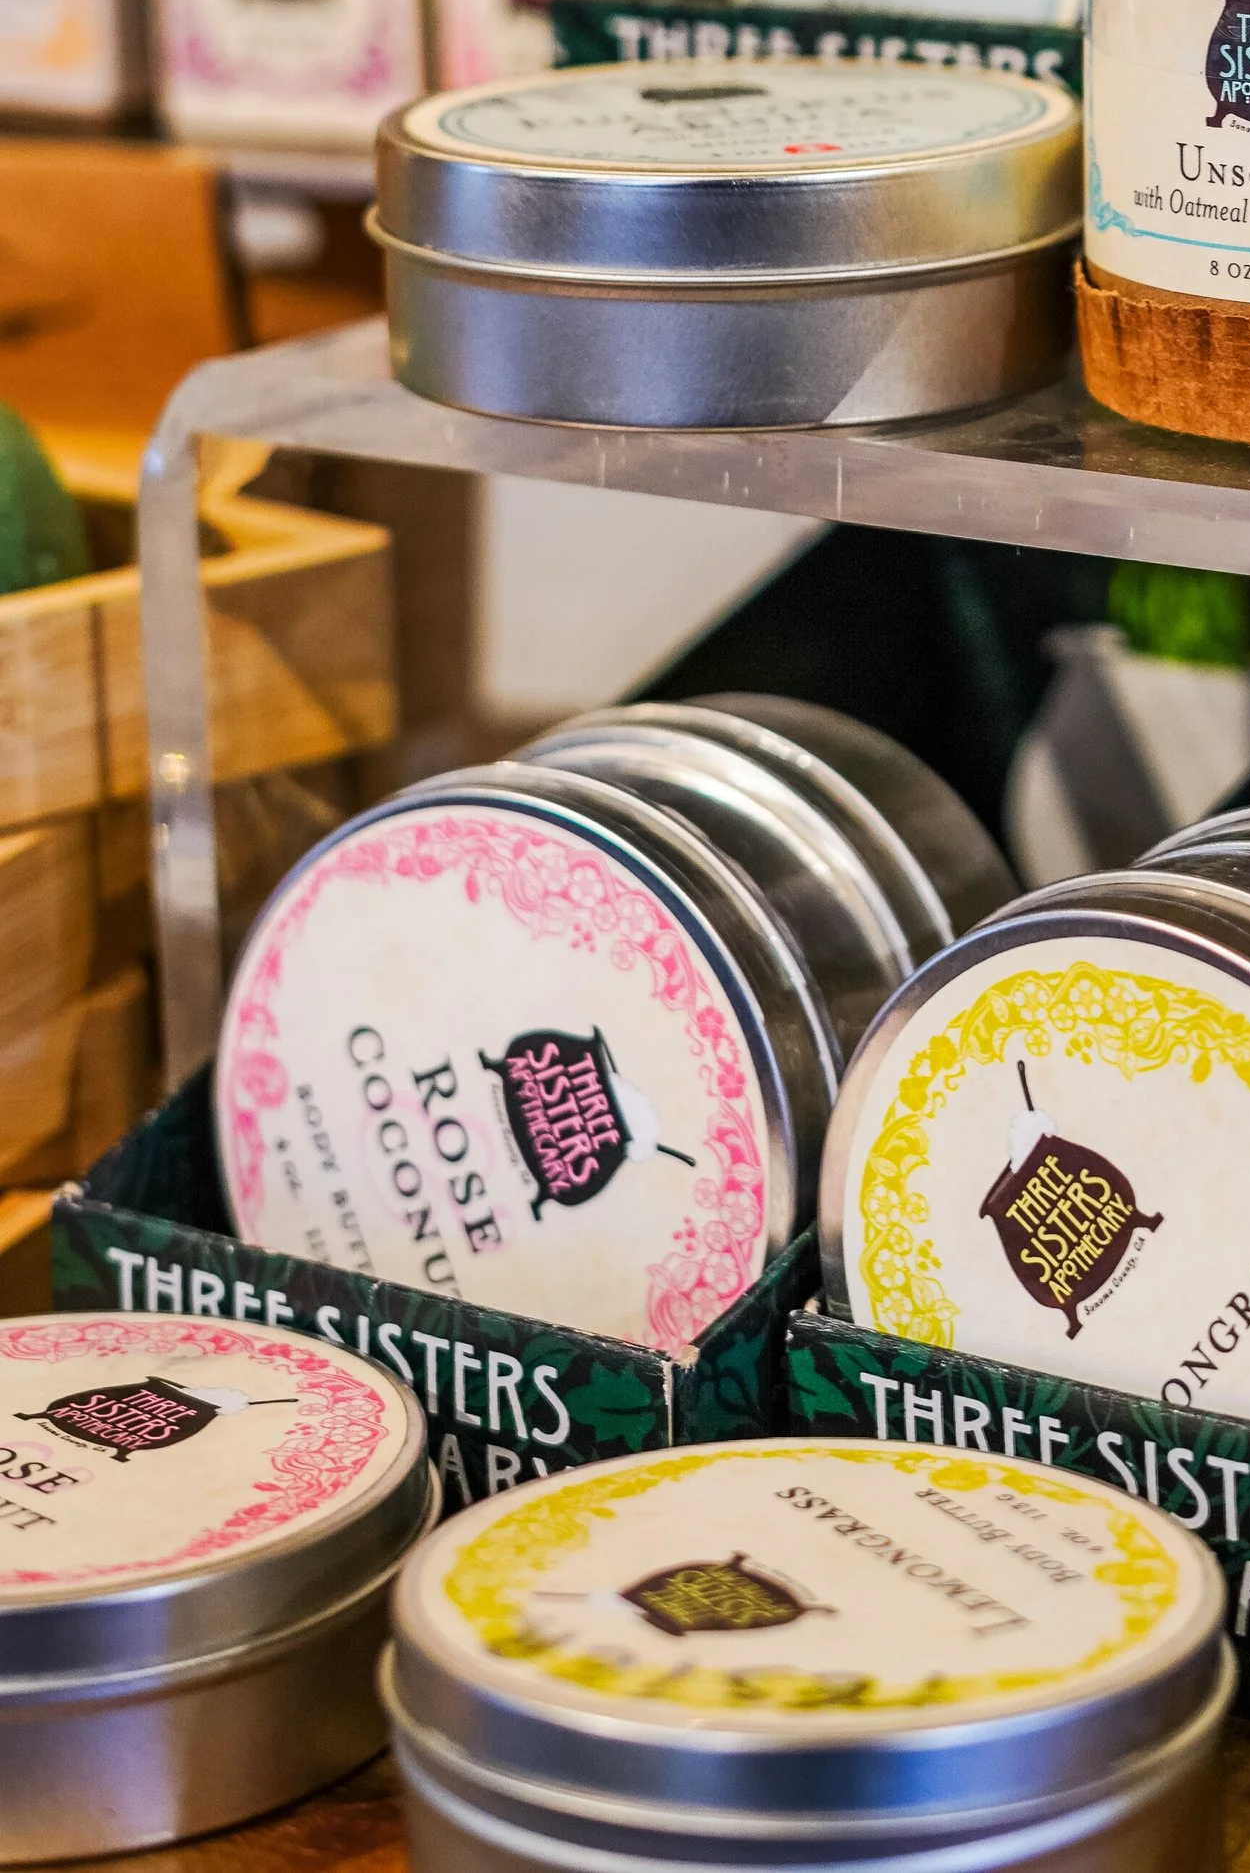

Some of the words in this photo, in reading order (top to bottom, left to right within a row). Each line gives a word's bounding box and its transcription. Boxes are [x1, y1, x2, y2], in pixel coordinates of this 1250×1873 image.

[1134, 186, 1164, 212] with
[1169, 189, 1248, 225] Oatmeal
[1210, 260, 1219, 277] 8
[525, 1042, 600, 1185] SISTERS
[567, 1051, 621, 1150] THREE
[347, 1026, 464, 1299] COCONU
[412, 1061, 503, 1255] ROSE
[1005, 1154, 1074, 1234] THREE
[1020, 1168, 1112, 1284] SISTERS
[69, 1395, 180, 1440] SISTERS
[122, 1389, 197, 1423] THREE
[916, 1487, 1013, 1543] BUTTER
[775, 1485, 1033, 1642] LEMONGRASS
[1004, 1543, 1086, 1585] BODY
